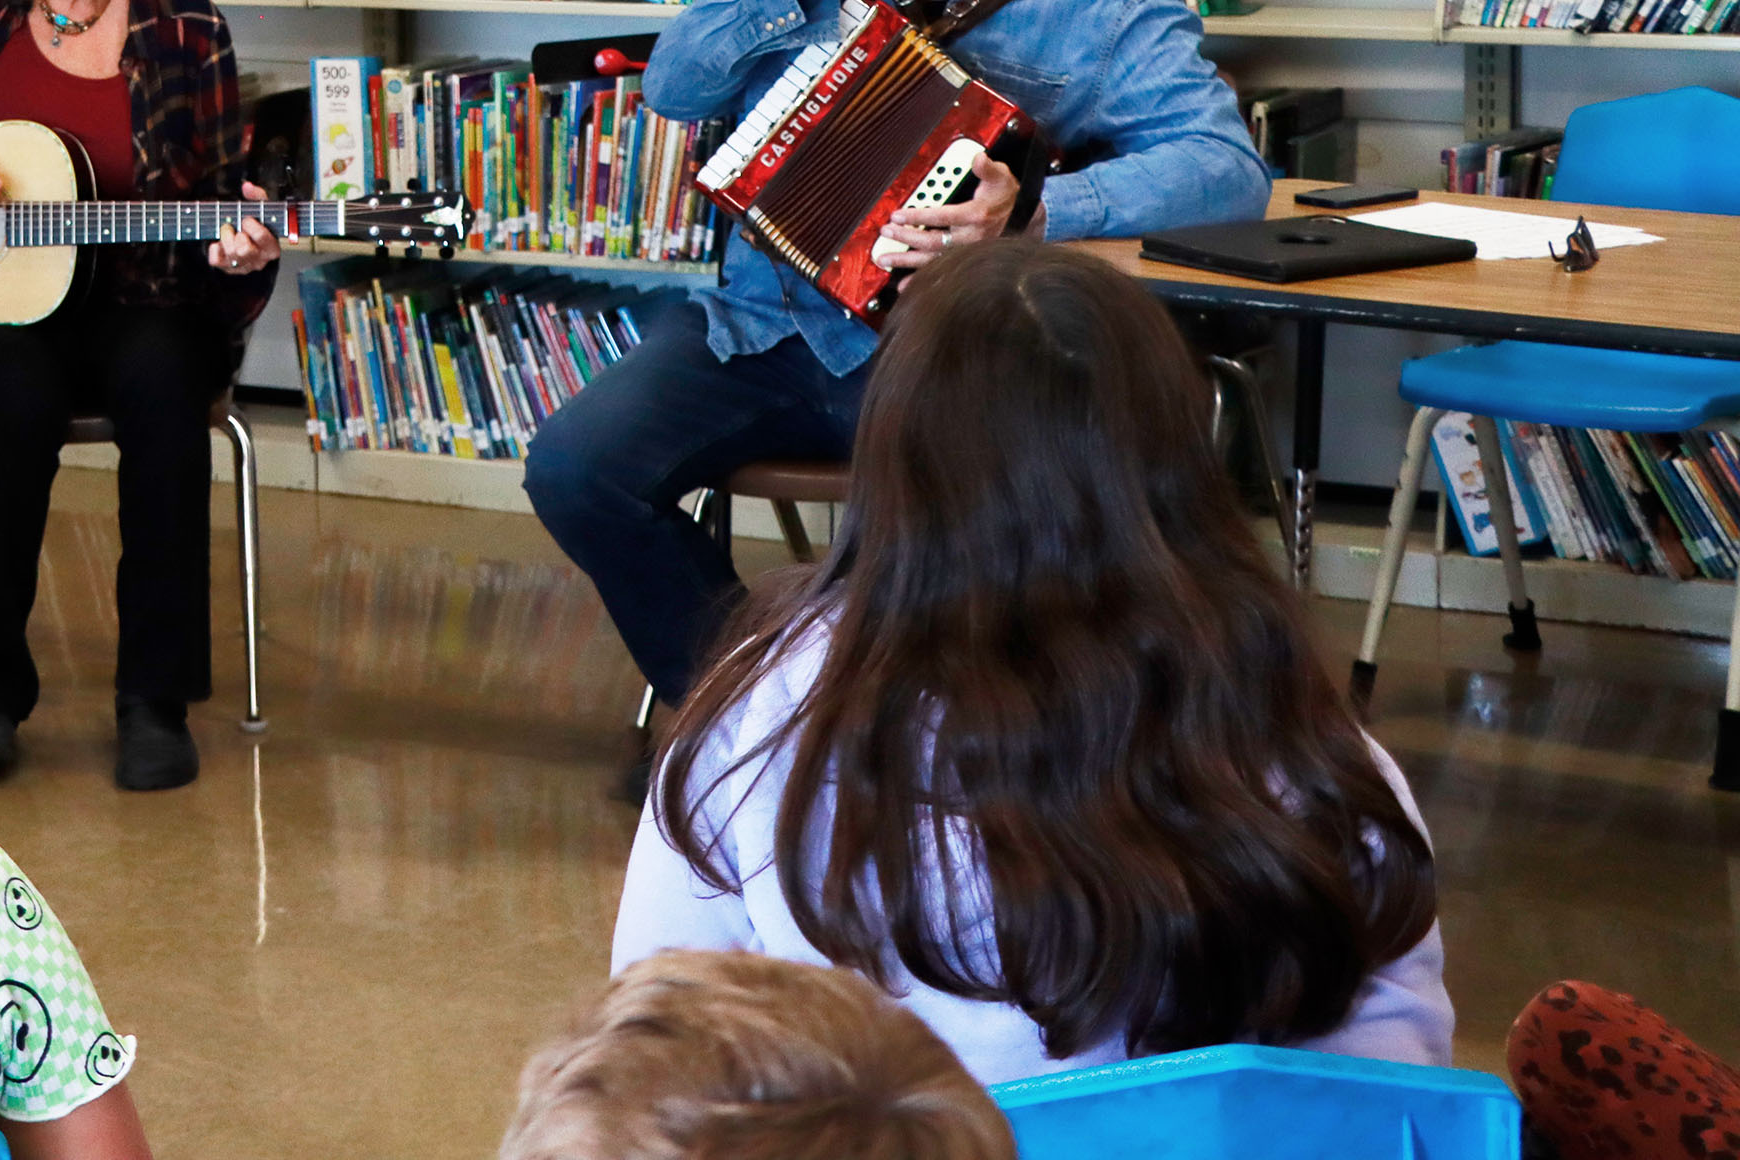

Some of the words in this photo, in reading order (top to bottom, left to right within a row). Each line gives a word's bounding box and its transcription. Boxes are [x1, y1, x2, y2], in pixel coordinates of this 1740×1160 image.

[322, 66, 352, 80] 500-
[325, 84, 350, 99] 599
[760, 45, 869, 168] CASTIGLIONE
